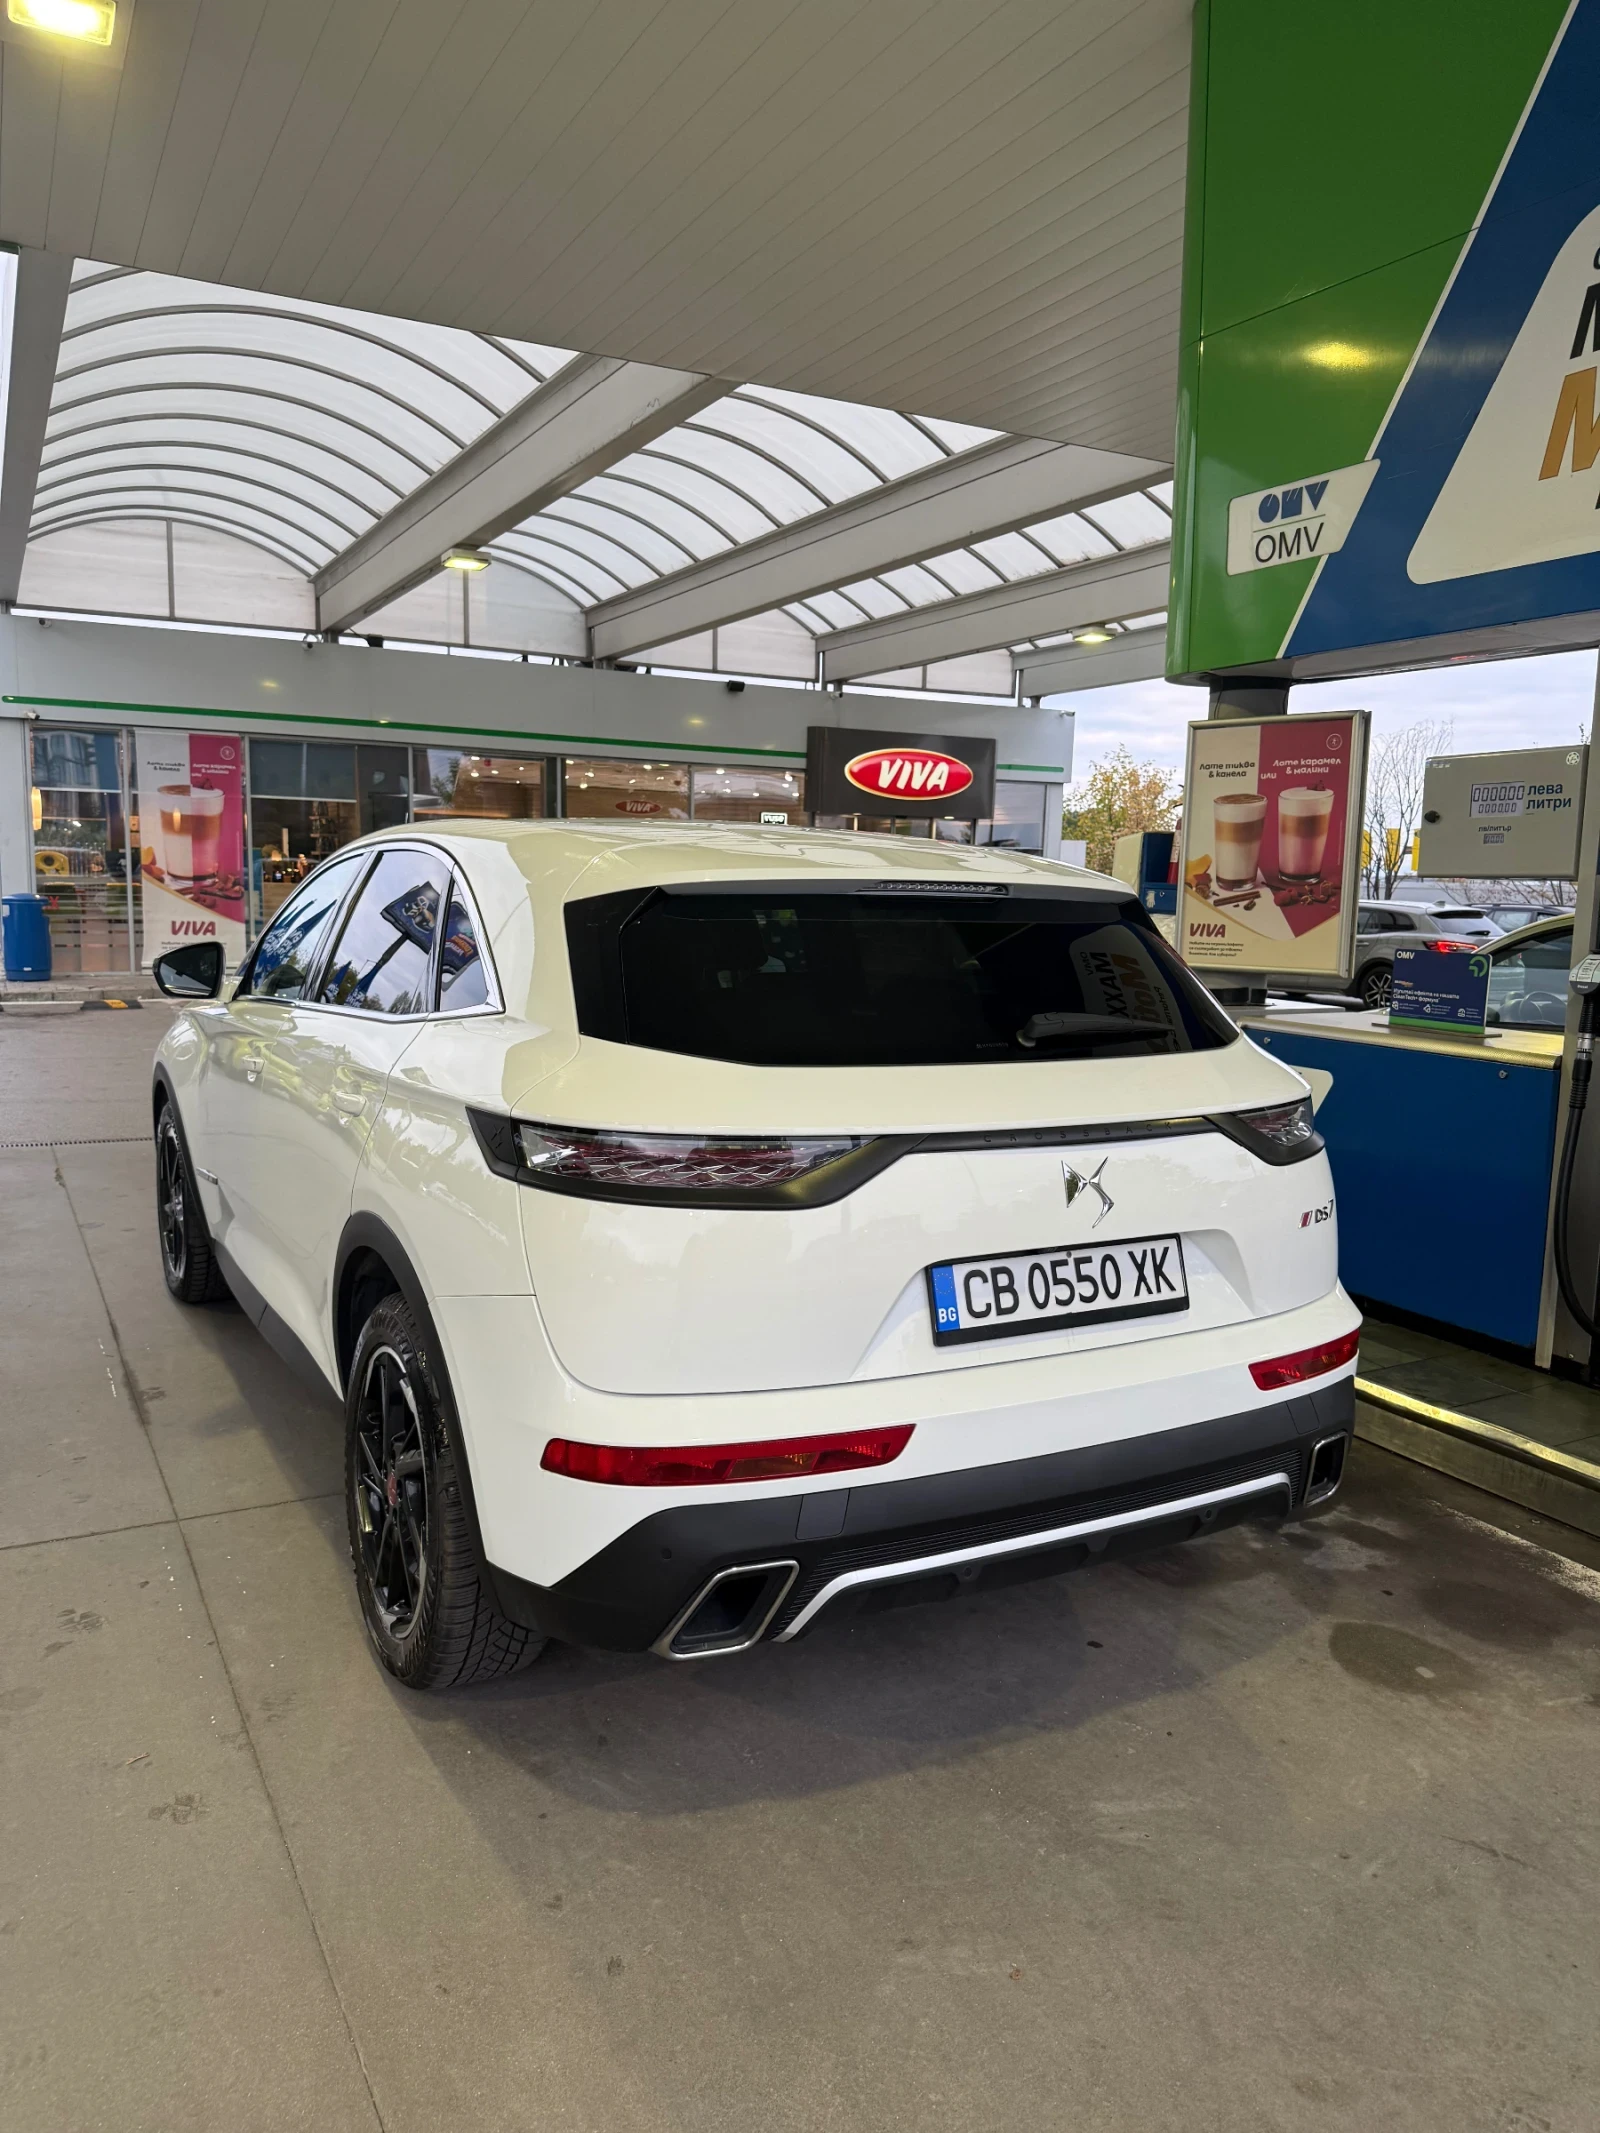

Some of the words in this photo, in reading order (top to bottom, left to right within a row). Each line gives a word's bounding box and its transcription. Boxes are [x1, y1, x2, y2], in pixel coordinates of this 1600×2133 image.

[1255, 522, 1324, 563] OMV
[1199, 763, 1224, 771] Лате
[1225, 761, 1255, 769] тиква
[1272, 759, 1299, 767] Лате
[1301, 757, 1341, 766] карамел
[878, 758, 950, 791] VIVA
[1216, 770, 1247, 778] канела
[1285, 767, 1292, 775] &
[1294, 766, 1329, 775] малини
[1527, 783, 1563, 796] лева
[625, 801, 651, 812] VIVA
[1526, 797, 1572, 812] литри
[171, 920, 216, 936] VIVA
[1189, 922, 1226, 938] VIVA
[1396, 951, 1415, 960] OMV
[983, 1121, 1172, 1143] CROSSBACK
[963, 1265, 1020, 1319] CB
[1028, 1253, 1121, 1310] 0550
[1127, 1246, 1177, 1297] XK
[938, 1306, 957, 1323] BG
